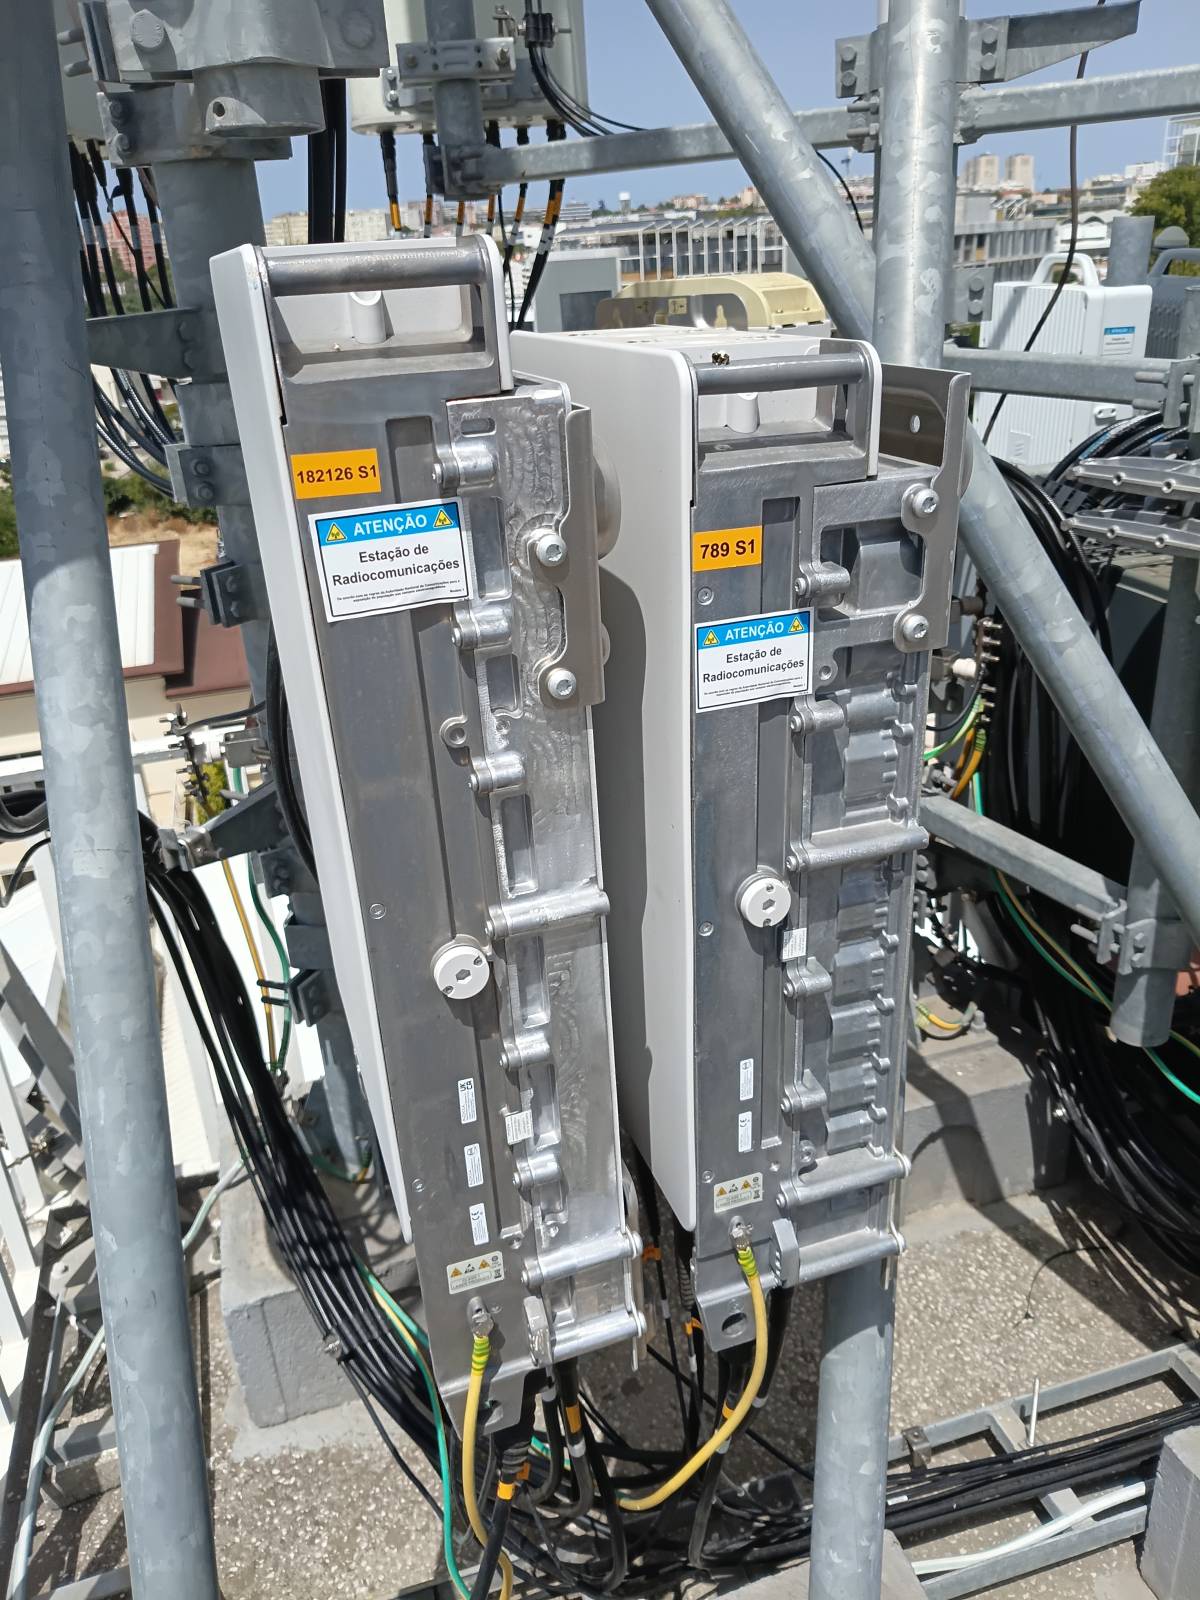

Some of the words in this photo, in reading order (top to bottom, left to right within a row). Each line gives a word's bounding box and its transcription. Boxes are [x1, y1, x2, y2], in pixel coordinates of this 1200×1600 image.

[297, 468, 353, 484] 182126
[358, 465, 377, 479] S1
[354, 514, 427, 536] ATENÇÃO
[359, 547, 410, 563] Estação
[414, 544, 429, 556] de
[700, 542, 730, 559] 789
[735, 539, 755, 556] S1
[332, 560, 460, 586] Radiocomunicações
[725, 621, 784, 640] ATENÇÃO
[726, 650, 766, 664] Estação
[770, 646, 782, 657] de
[703, 659, 804, 683] Radiocomunicações
